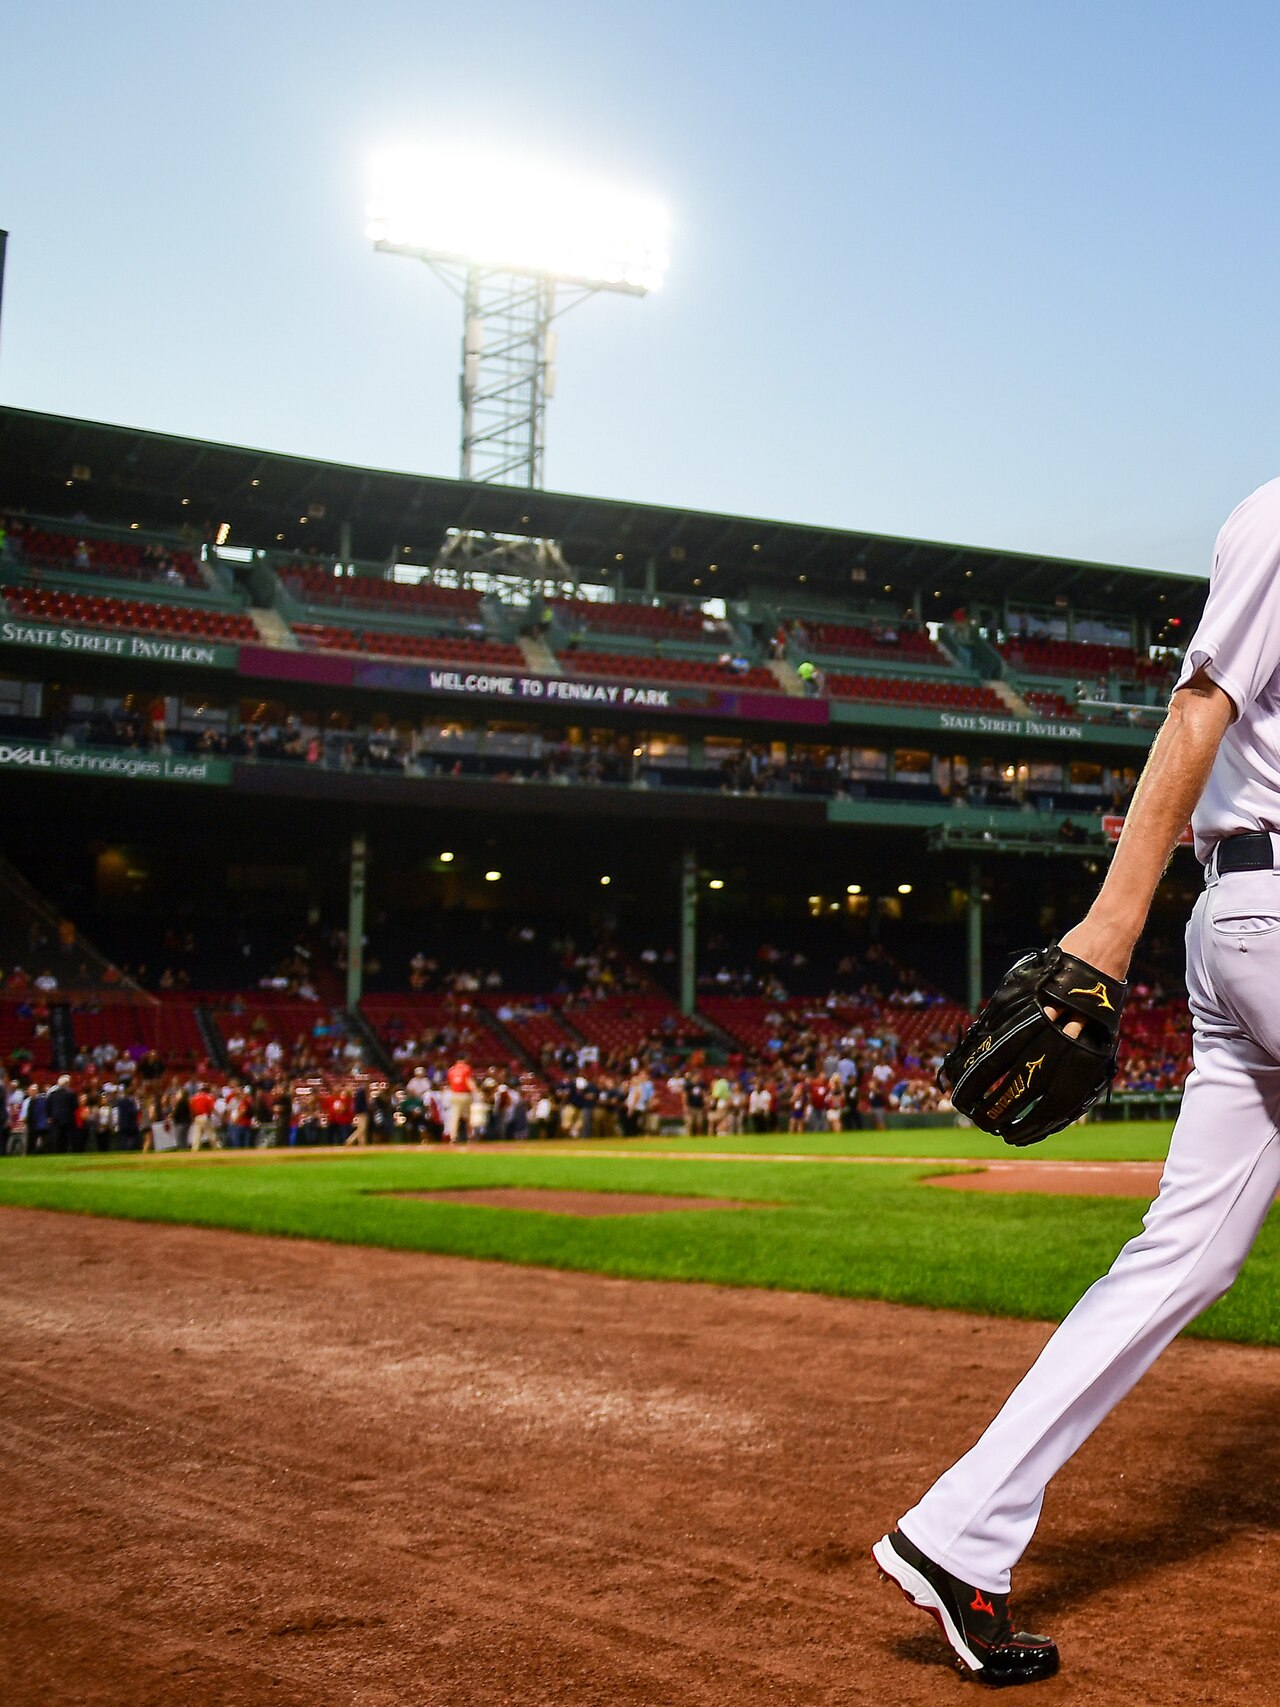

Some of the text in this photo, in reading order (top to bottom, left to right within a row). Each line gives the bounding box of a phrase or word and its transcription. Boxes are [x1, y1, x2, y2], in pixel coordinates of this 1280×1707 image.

[2, 622, 215, 664] STATE STREET PAVILION
[430, 672, 670, 706] WELCOME TO FENWAY PARK
[940, 713, 1083, 739] STATE STREET PAVILION
[53, 750, 160, 777] Technologies
[164, 759, 207, 779] Level
